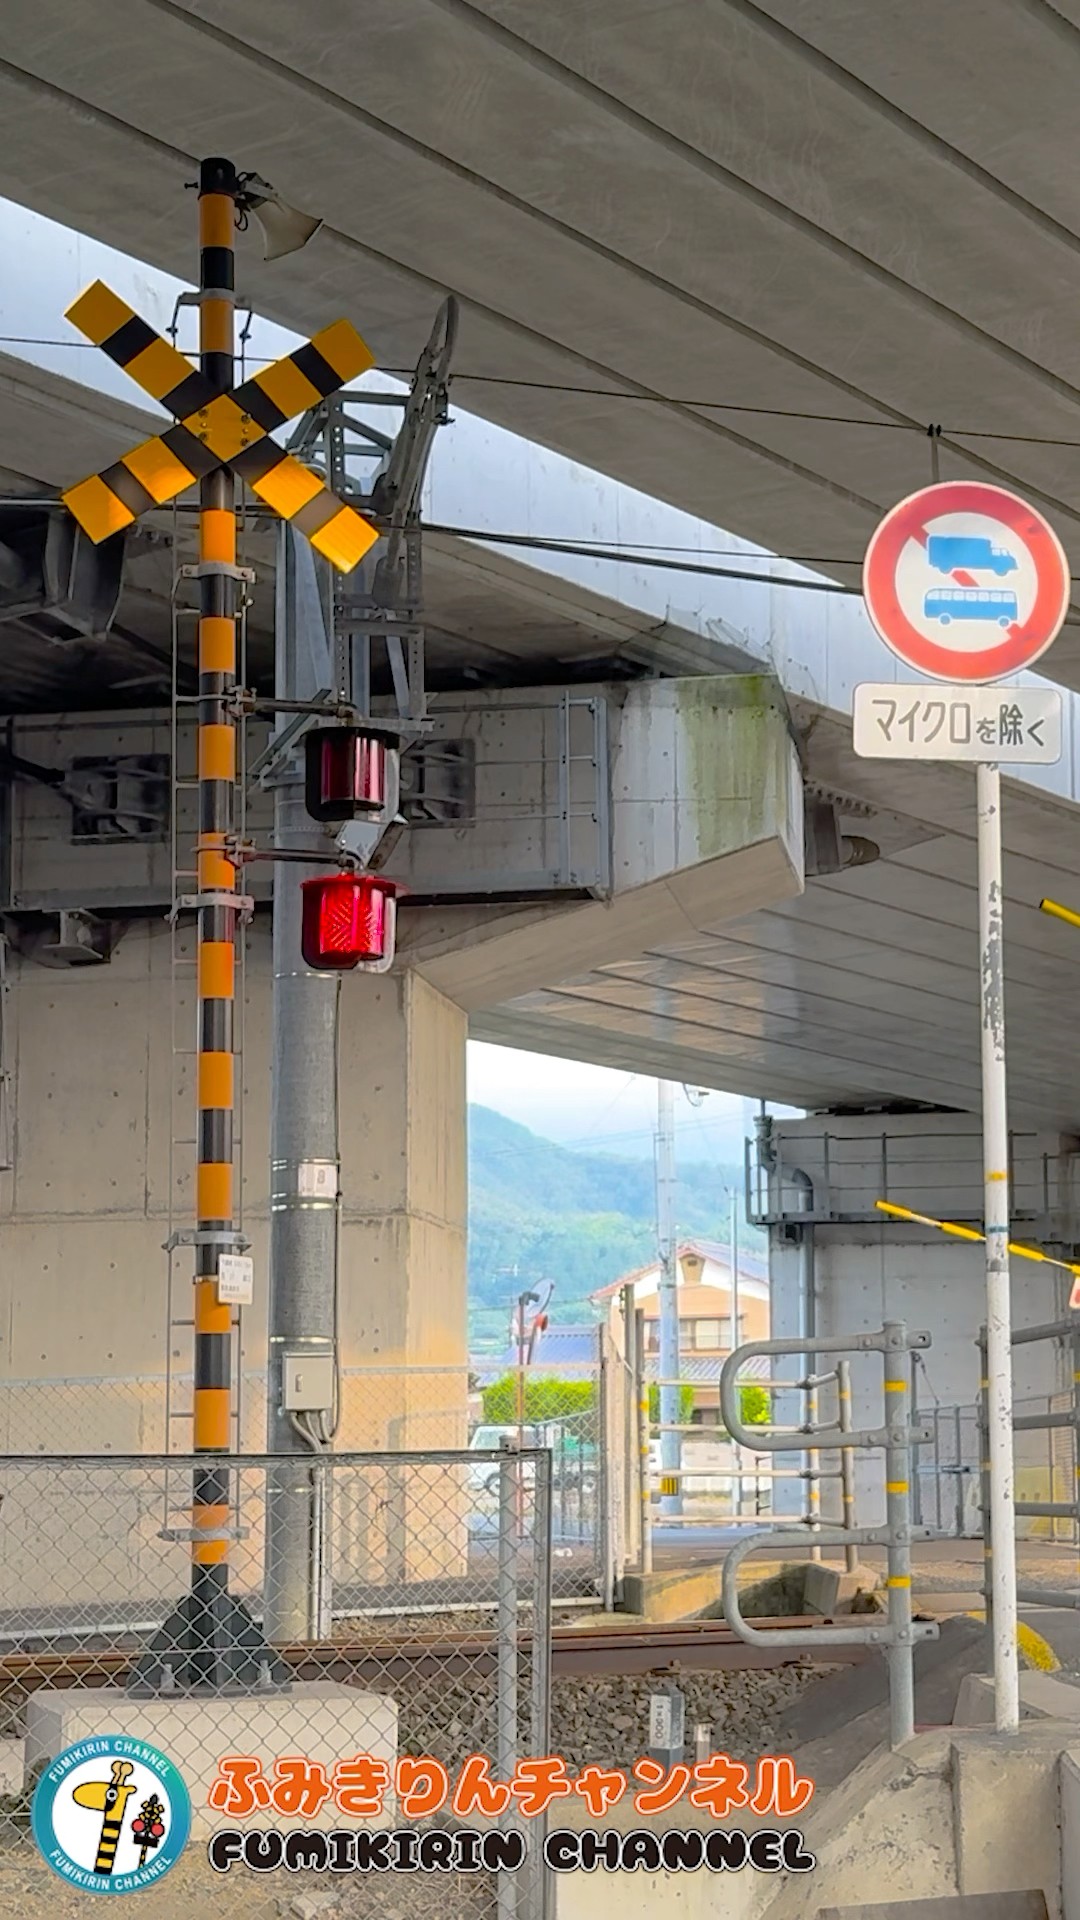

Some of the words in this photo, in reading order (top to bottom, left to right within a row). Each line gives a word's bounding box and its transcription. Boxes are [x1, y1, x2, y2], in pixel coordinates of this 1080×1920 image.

[872, 699, 1044, 747] マイクロを除く
